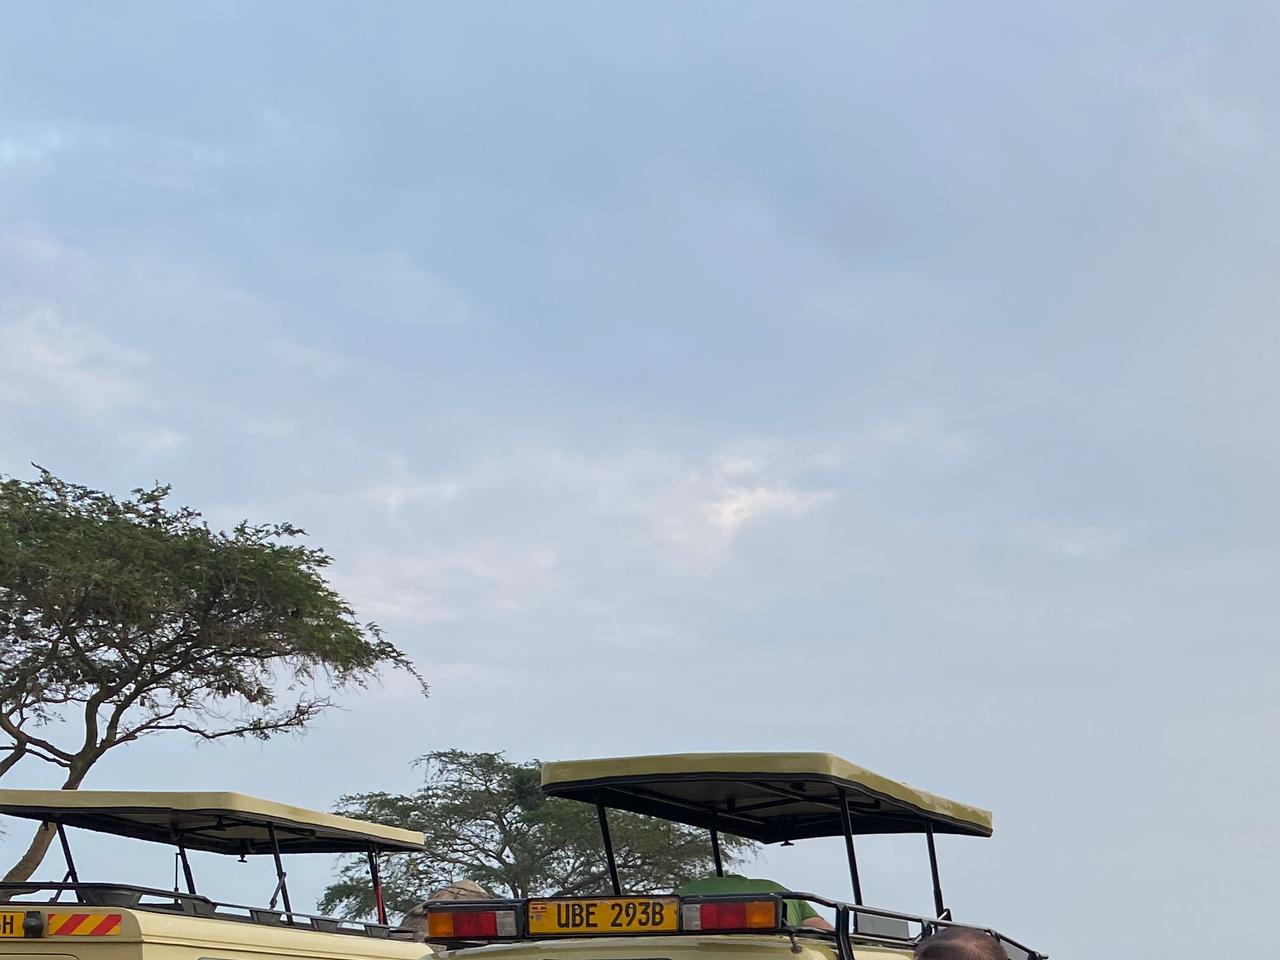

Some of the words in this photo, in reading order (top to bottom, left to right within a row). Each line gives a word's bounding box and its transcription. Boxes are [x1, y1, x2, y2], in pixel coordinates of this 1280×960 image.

[0, 914, 14, 934] H
[557, 903, 598, 928] UBE
[610, 902, 665, 928] 293B
